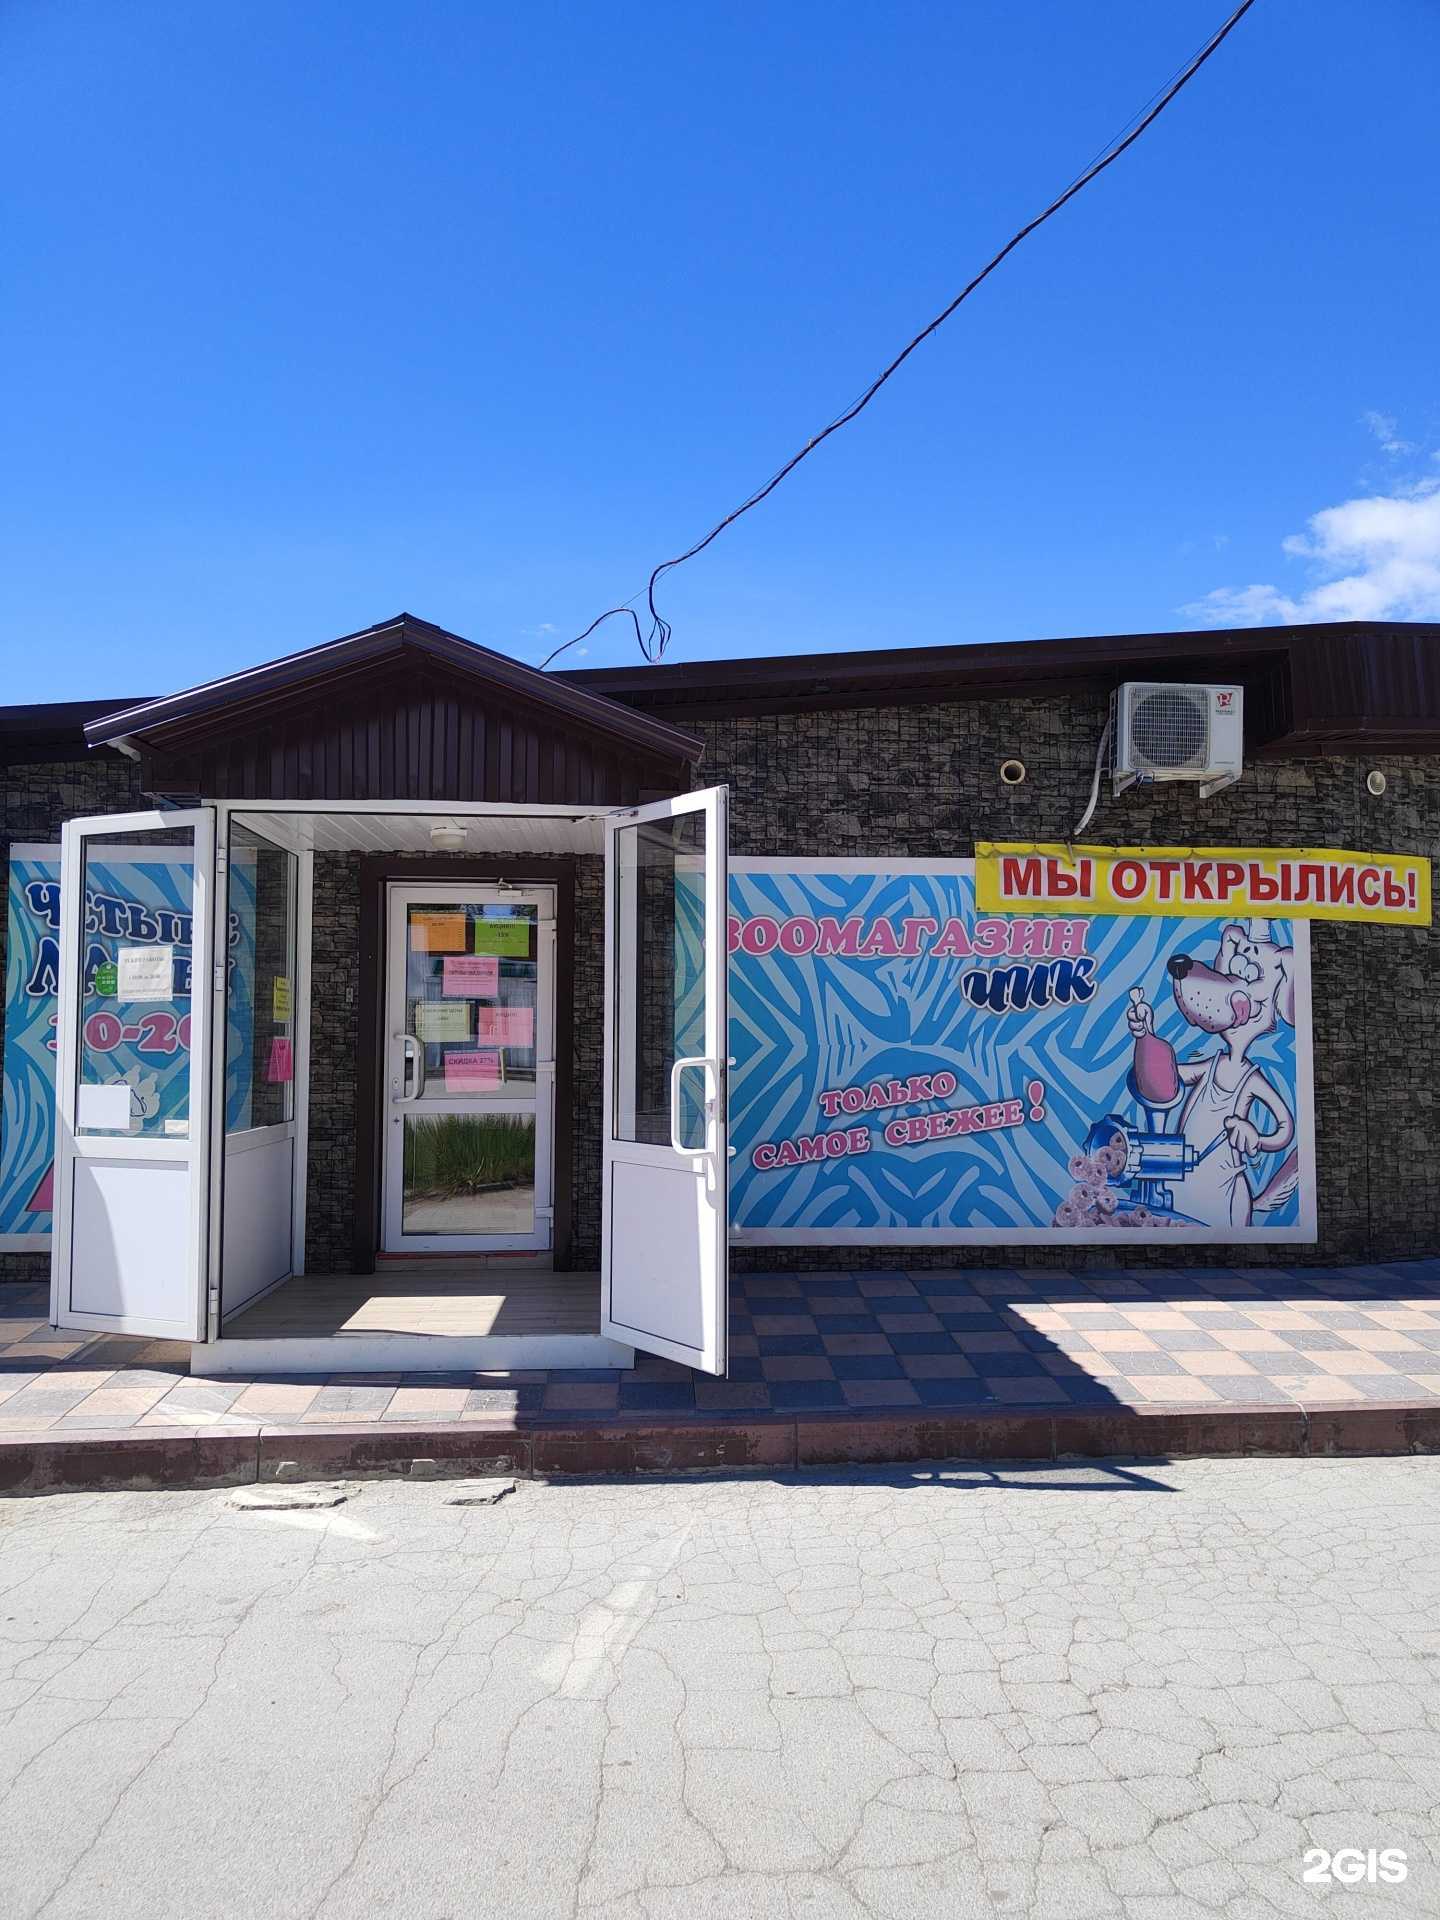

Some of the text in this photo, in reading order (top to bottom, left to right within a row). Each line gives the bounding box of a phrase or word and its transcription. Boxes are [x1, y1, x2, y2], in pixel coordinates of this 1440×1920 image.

[1003, 858, 1416, 909] МЫ ОТКРЫЛИСЬ!
[47, 1011, 192, 1054] 0-2
[820, 1072, 956, 1117] ТОЛЬКО
[752, 1127, 870, 1169] САМОЕ
